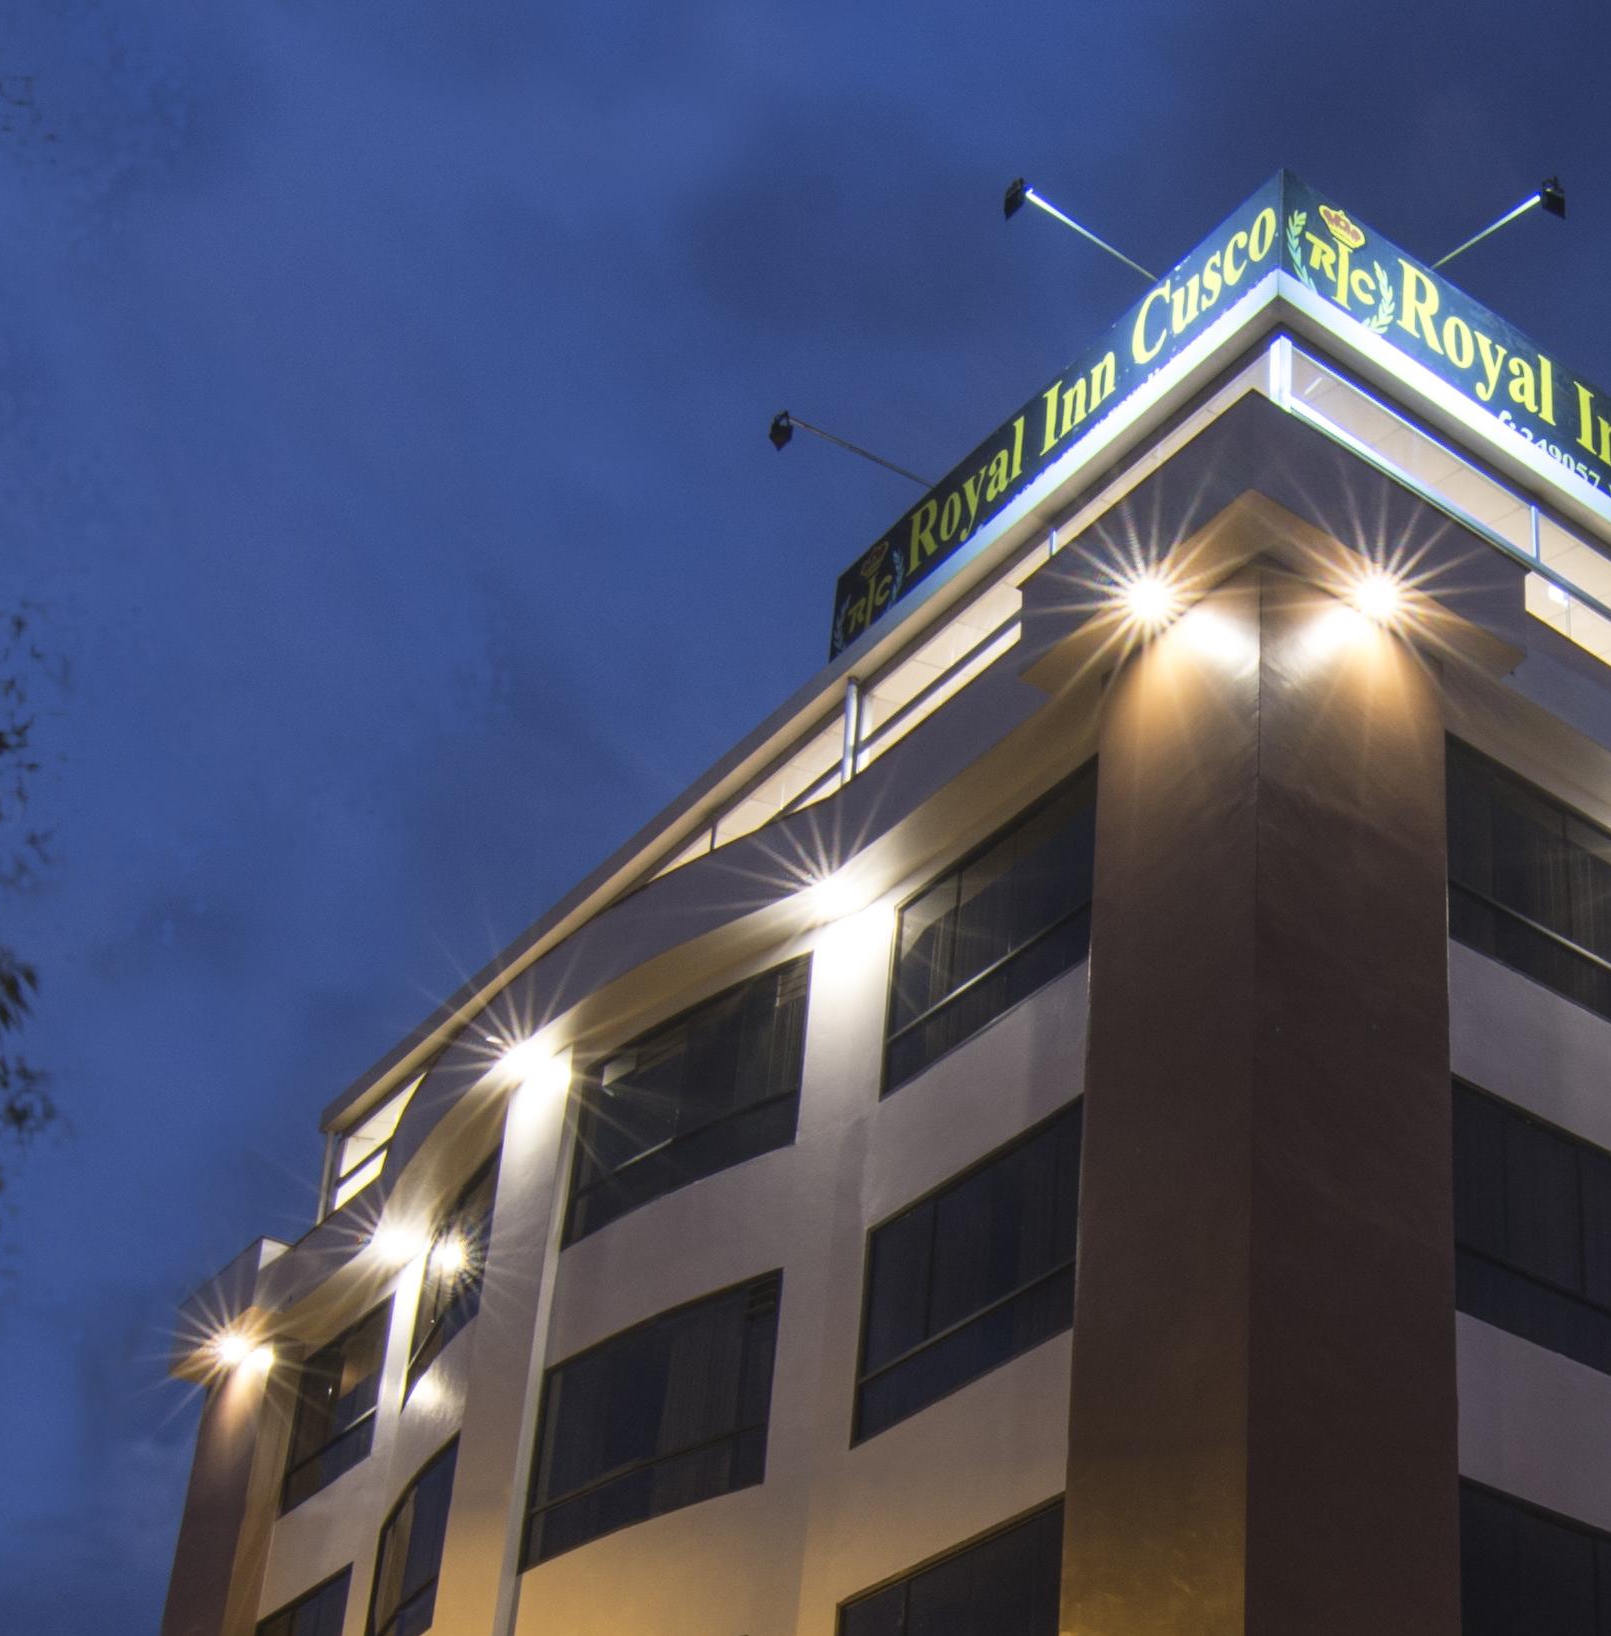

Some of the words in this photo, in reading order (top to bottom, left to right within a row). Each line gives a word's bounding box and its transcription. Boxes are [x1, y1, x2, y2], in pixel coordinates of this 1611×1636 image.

[905, 416, 1025, 576] Royal
[1039, 352, 1116, 456] Inn
[1131, 207, 1278, 365] Cusco
[1396, 258, 1557, 426] Royal
